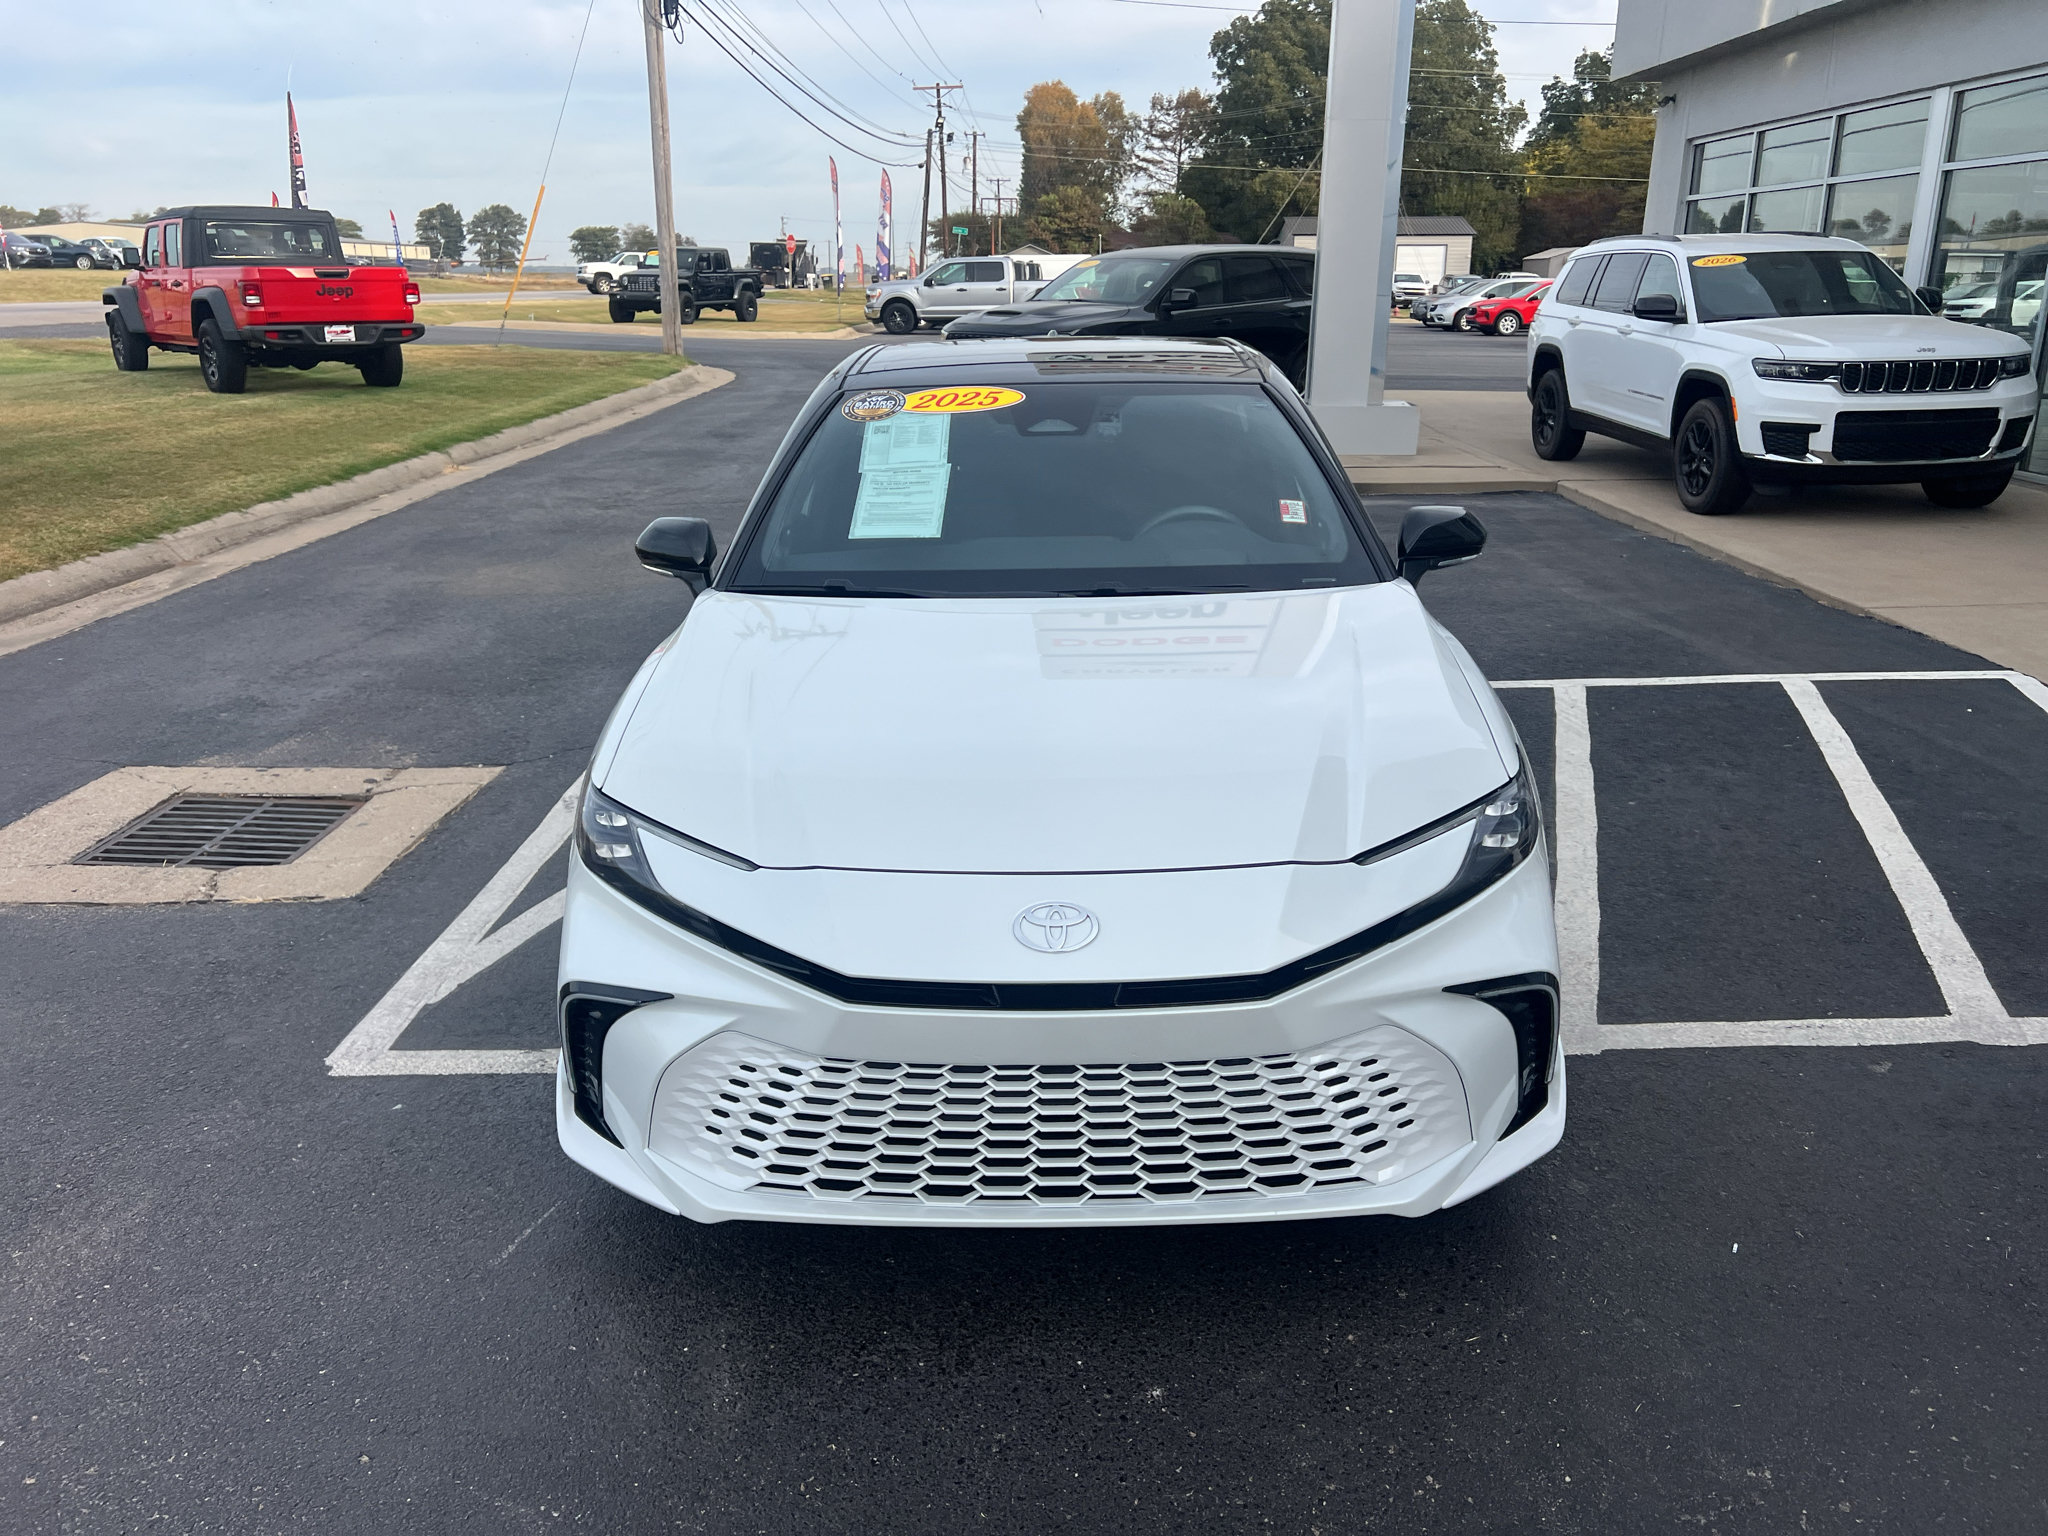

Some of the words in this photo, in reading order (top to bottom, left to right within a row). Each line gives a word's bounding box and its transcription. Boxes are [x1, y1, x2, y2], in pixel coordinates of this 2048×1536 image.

[1702, 256, 1737, 266] 2026
[316, 284, 354, 298] Jeep
[911, 390, 1004, 409] 2025
